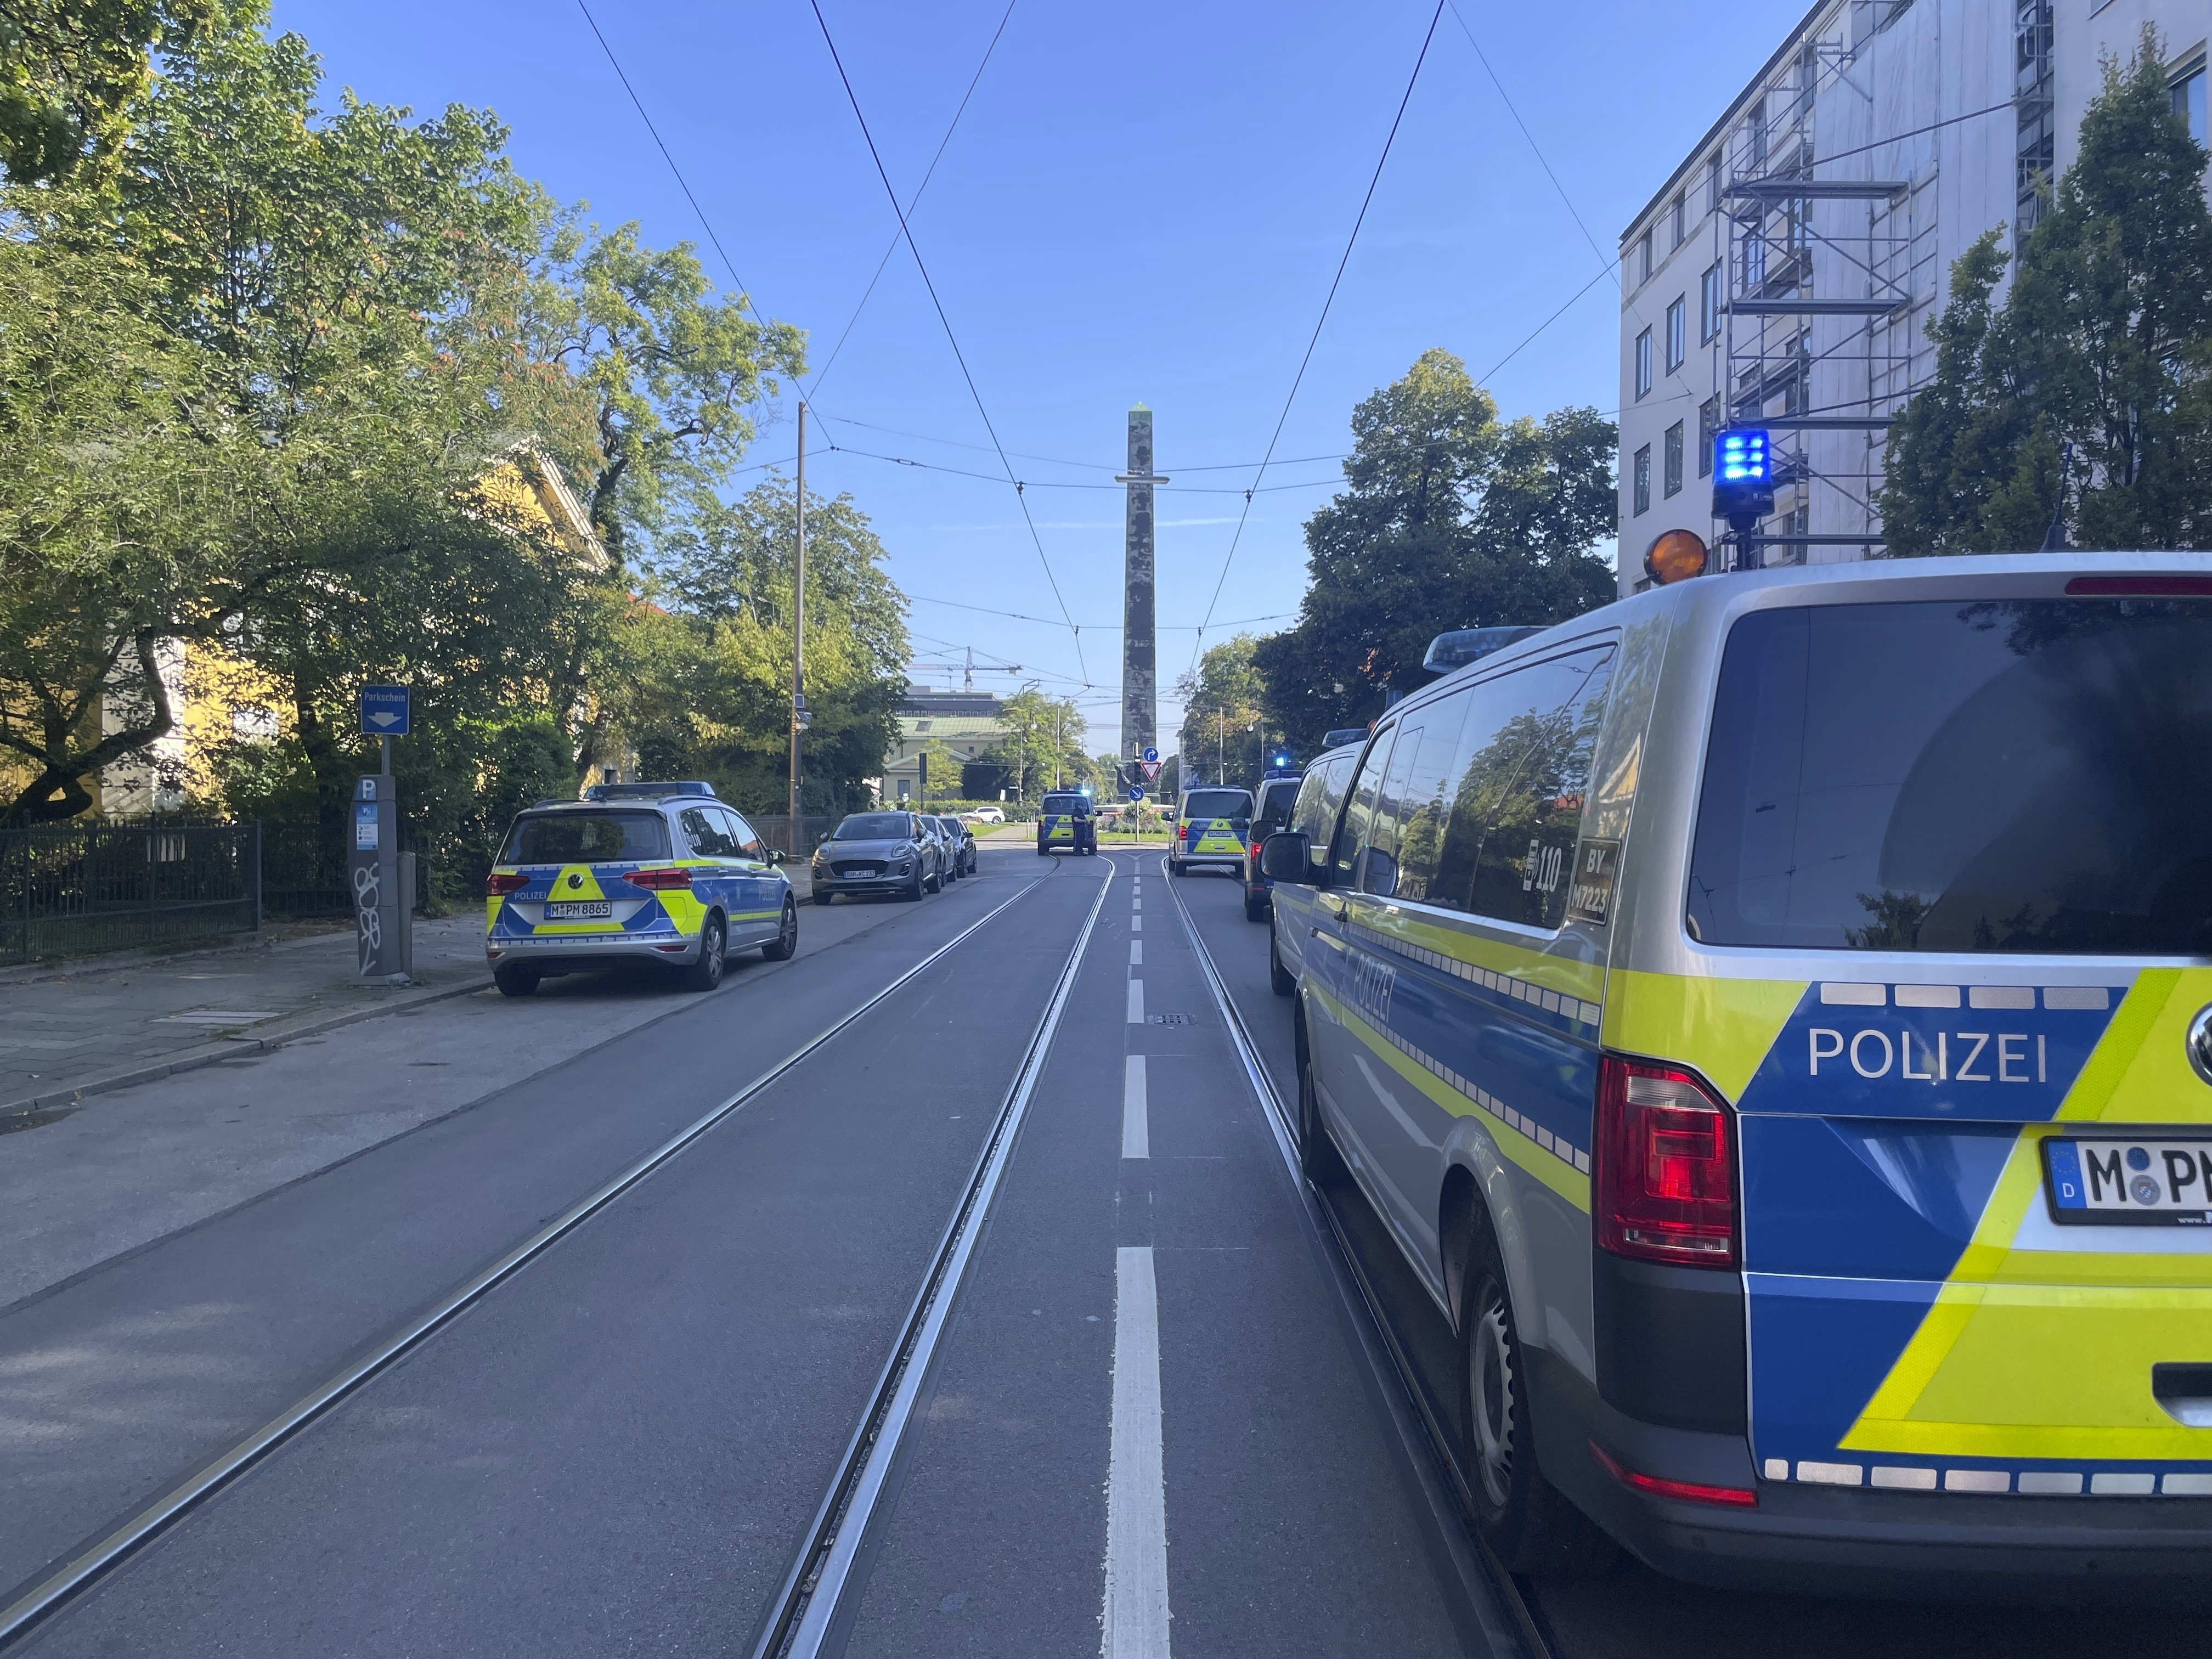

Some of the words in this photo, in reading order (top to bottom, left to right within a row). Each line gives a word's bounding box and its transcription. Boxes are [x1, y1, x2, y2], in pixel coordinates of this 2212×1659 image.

[364, 692, 406, 702] Parkschein
[363, 779, 375, 799] P
[1536, 846, 1562, 893] 110
[1586, 849, 1606, 873] BY
[515, 891, 546, 900] POLIZEI
[1571, 884, 1608, 913] M7223
[552, 906, 558, 916] M
[566, 905, 580, 915] PM
[582, 904, 608, 914] 8865
[1353, 953, 1397, 1023] POLIZEI
[1809, 1028, 2046, 1083] POLIZEI
[2086, 1149, 2126, 1201] M
[2062, 1183, 2075, 1198] D
